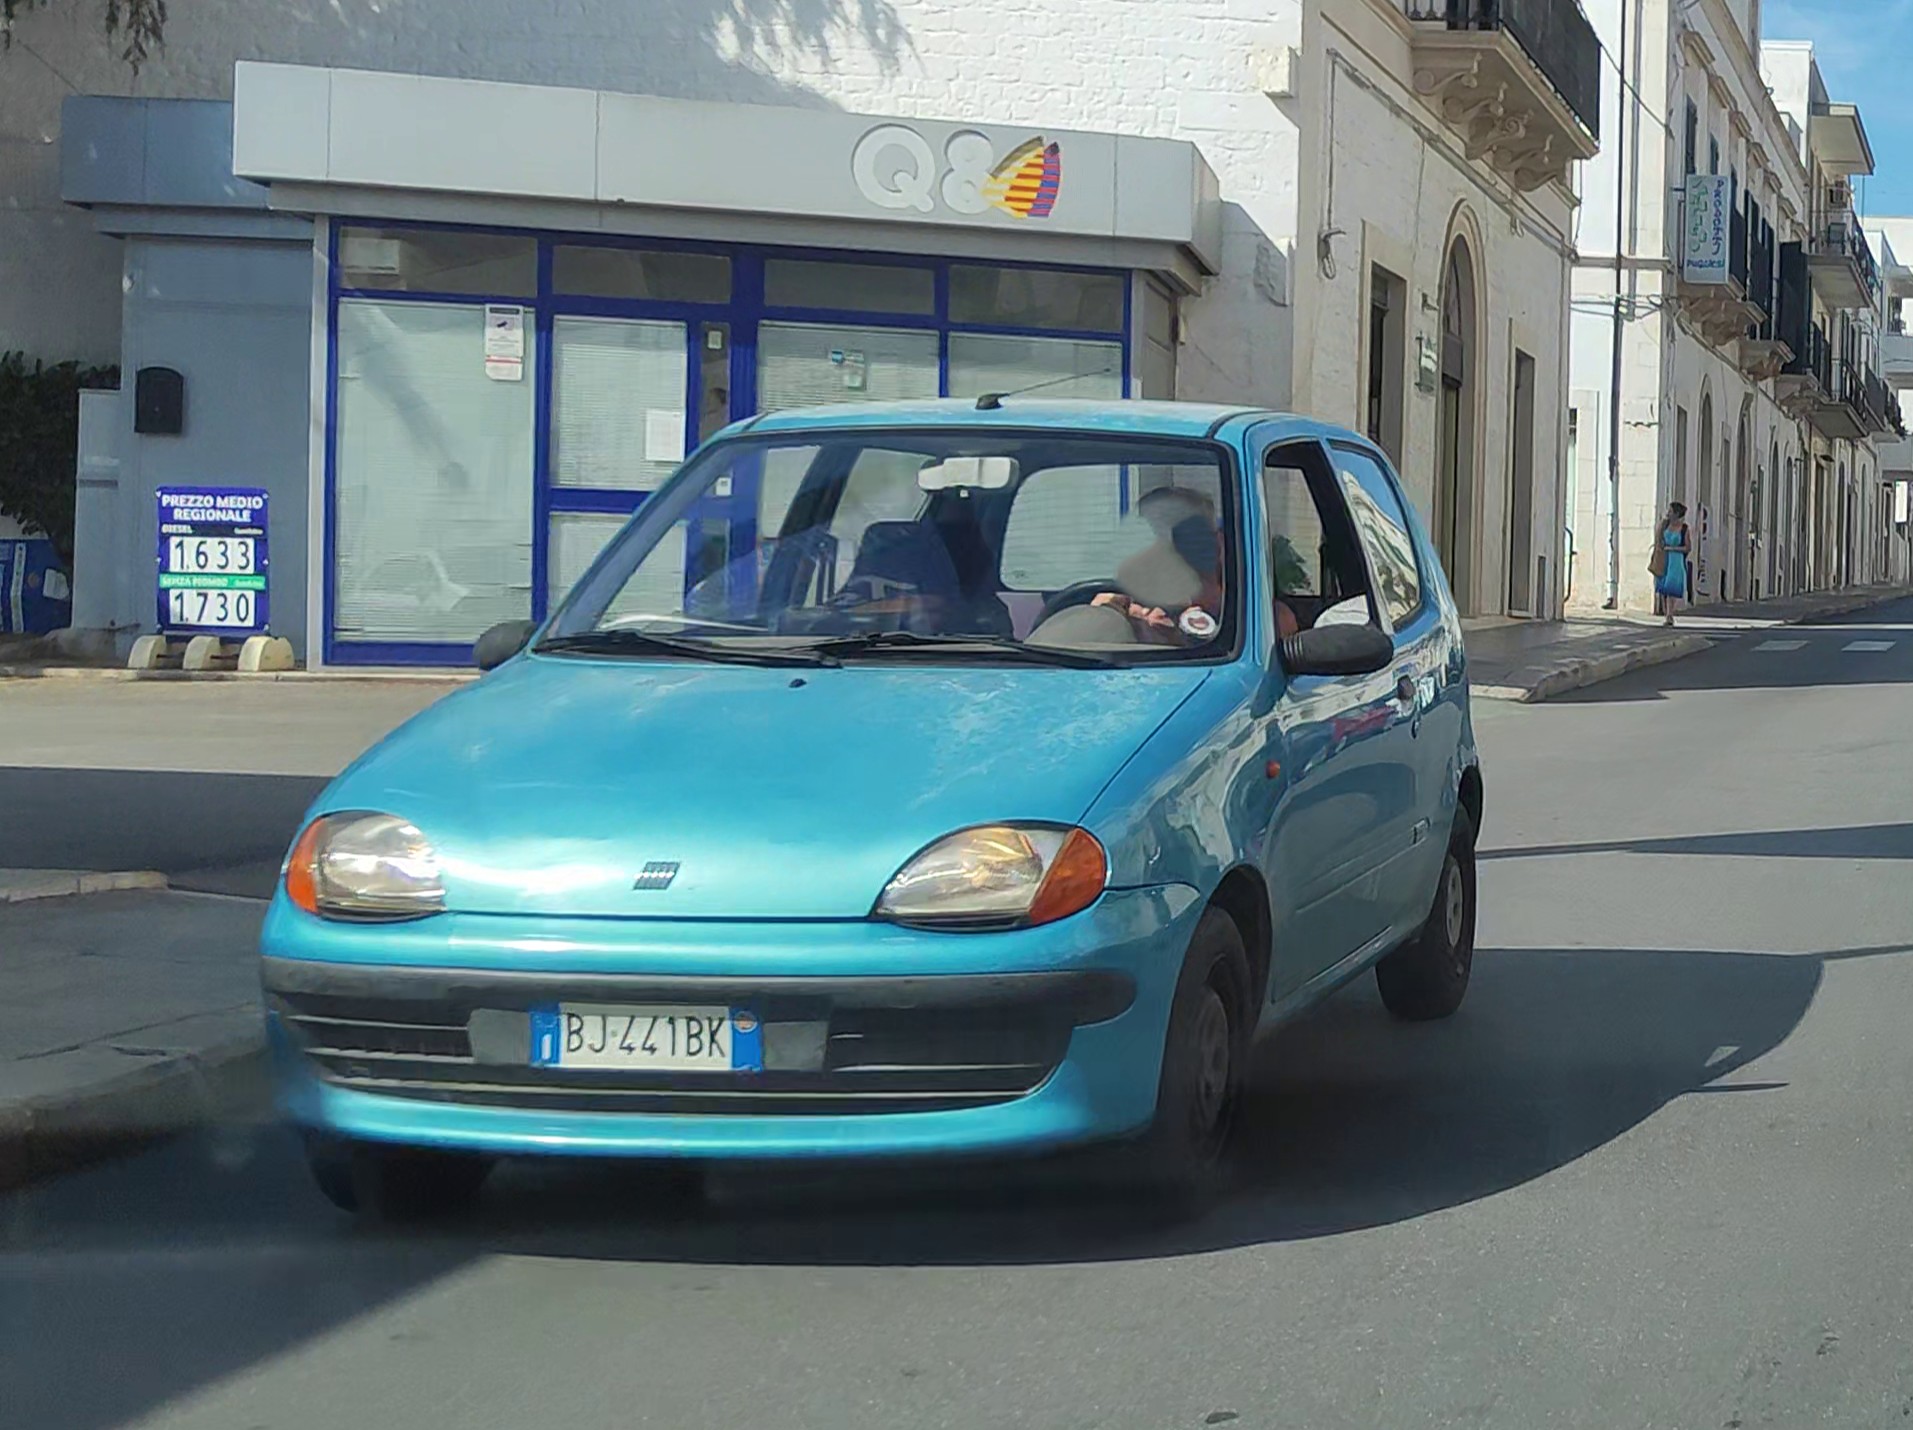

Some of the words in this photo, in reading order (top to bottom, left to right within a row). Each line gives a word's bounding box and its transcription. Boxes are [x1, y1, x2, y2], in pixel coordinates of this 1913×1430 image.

[162, 494, 214, 508] PREZZO
[216, 496, 264, 510] MEDIO
[173, 508, 252, 523] REGIONALE
